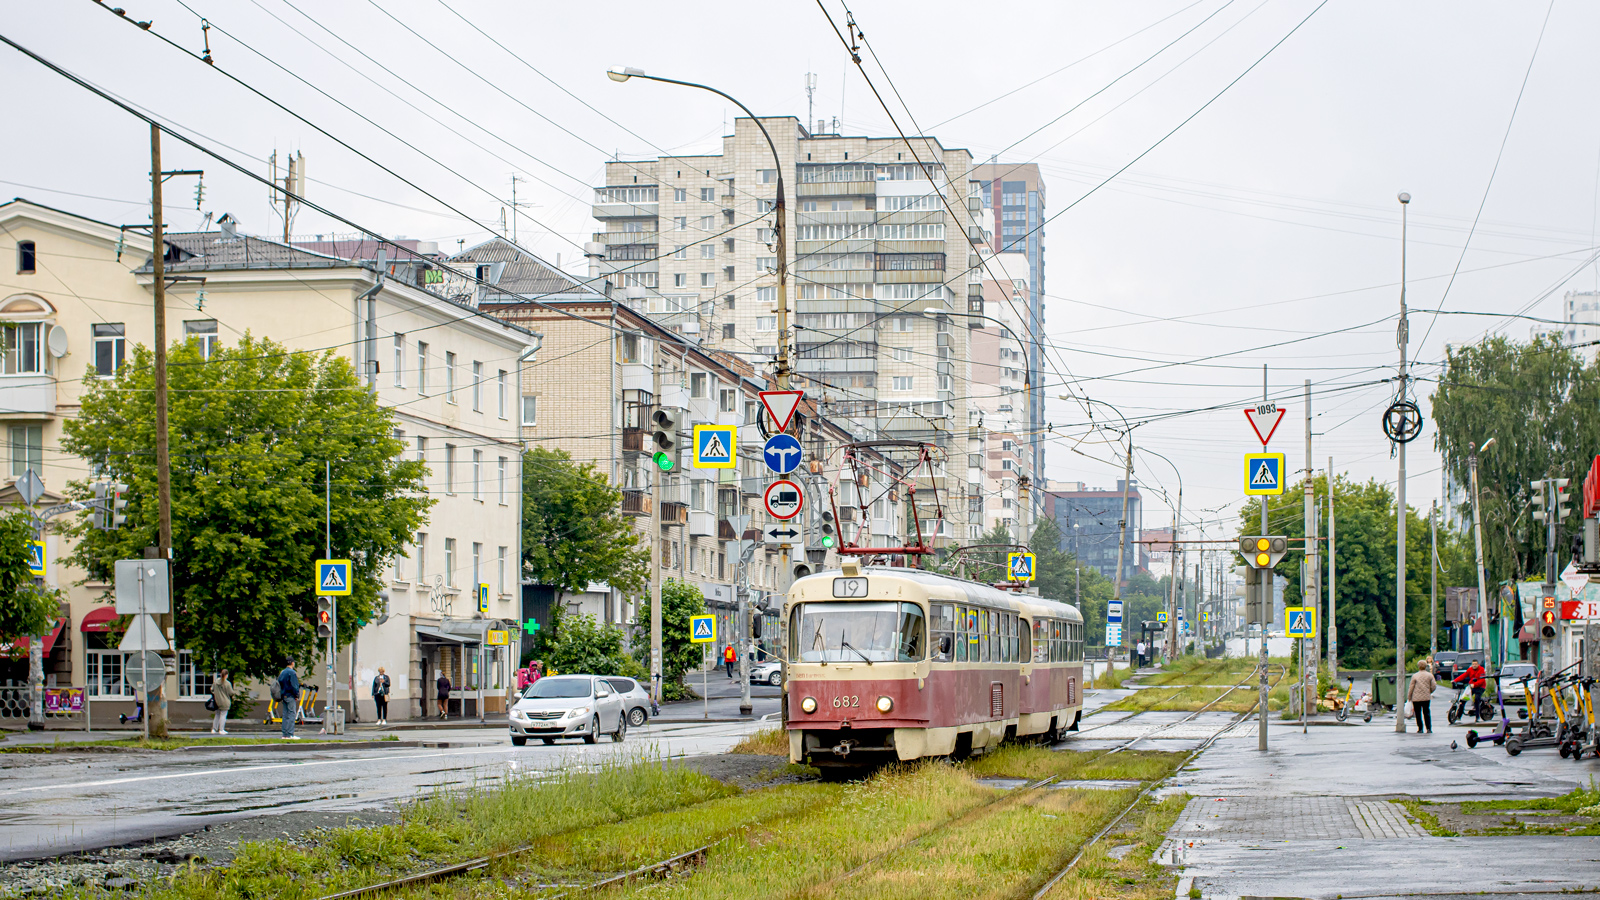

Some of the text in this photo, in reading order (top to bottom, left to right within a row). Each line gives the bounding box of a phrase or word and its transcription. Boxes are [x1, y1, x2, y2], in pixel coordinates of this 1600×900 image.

[1256, 403, 1277, 415] 1093
[842, 580, 859, 597] 19
[1544, 597, 1555, 608] 25
[833, 695, 860, 708] 682
